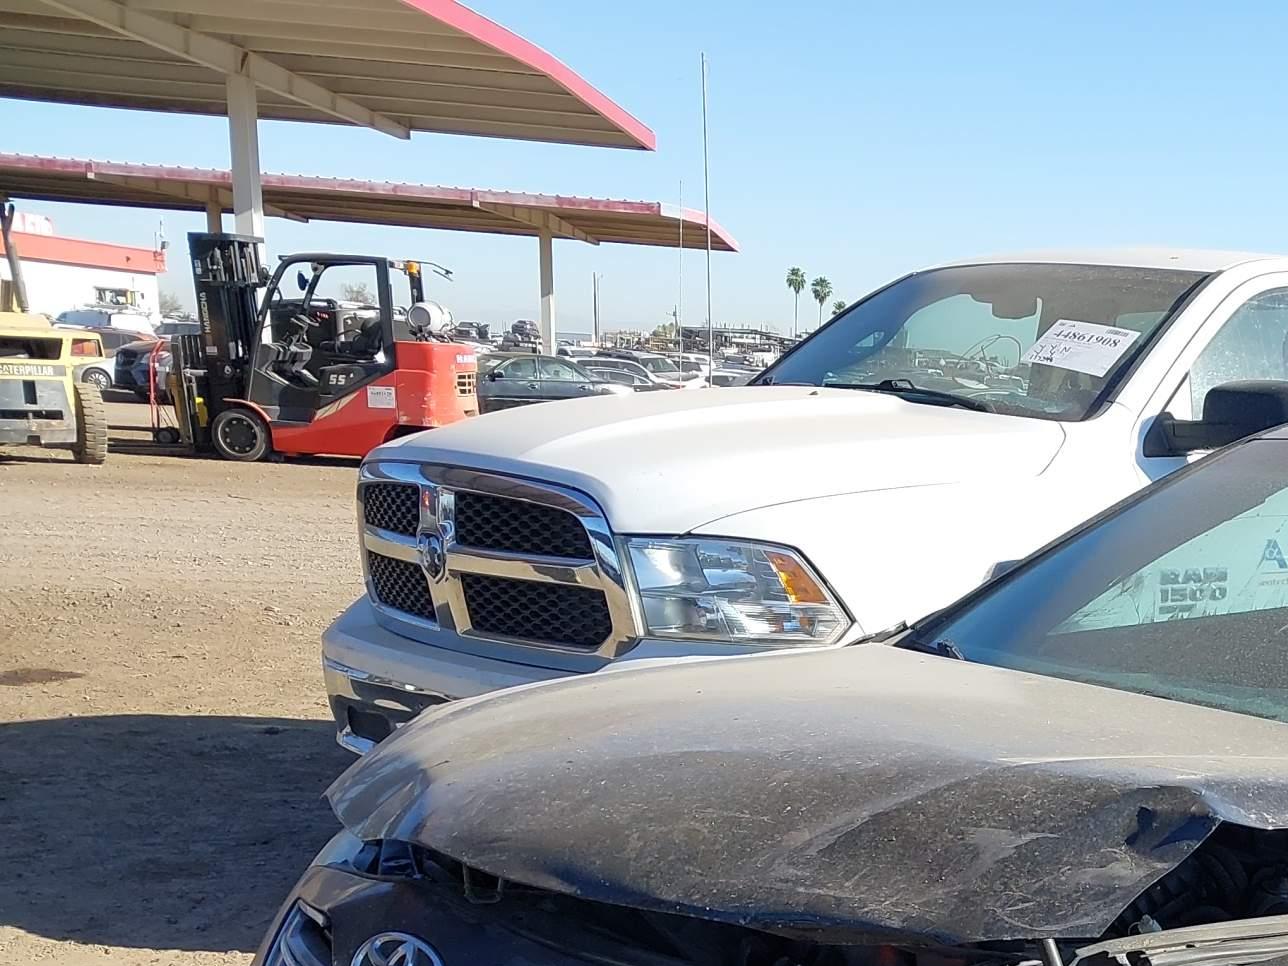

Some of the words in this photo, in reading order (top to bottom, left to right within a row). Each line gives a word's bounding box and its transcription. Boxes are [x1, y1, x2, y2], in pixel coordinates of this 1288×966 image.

[1054, 329, 1121, 348] 44861908
[1160, 567, 1227, 585] RAM
[1160, 586, 1227, 603] 1500
